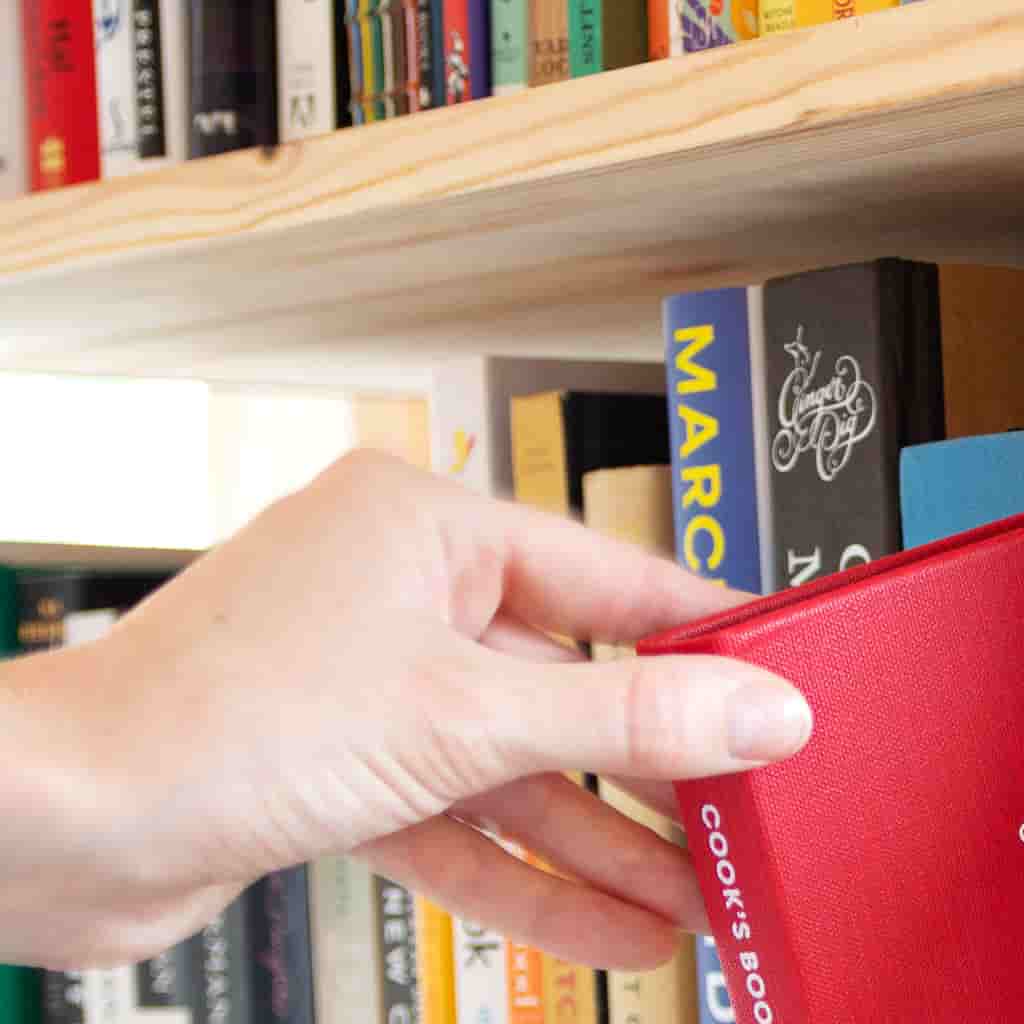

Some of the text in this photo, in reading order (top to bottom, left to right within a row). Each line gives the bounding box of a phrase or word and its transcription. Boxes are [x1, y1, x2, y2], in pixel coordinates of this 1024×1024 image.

[673, 324, 730, 588] MARC
[383, 886, 412, 986] NEW
[701, 803, 751, 941] COOK'S
